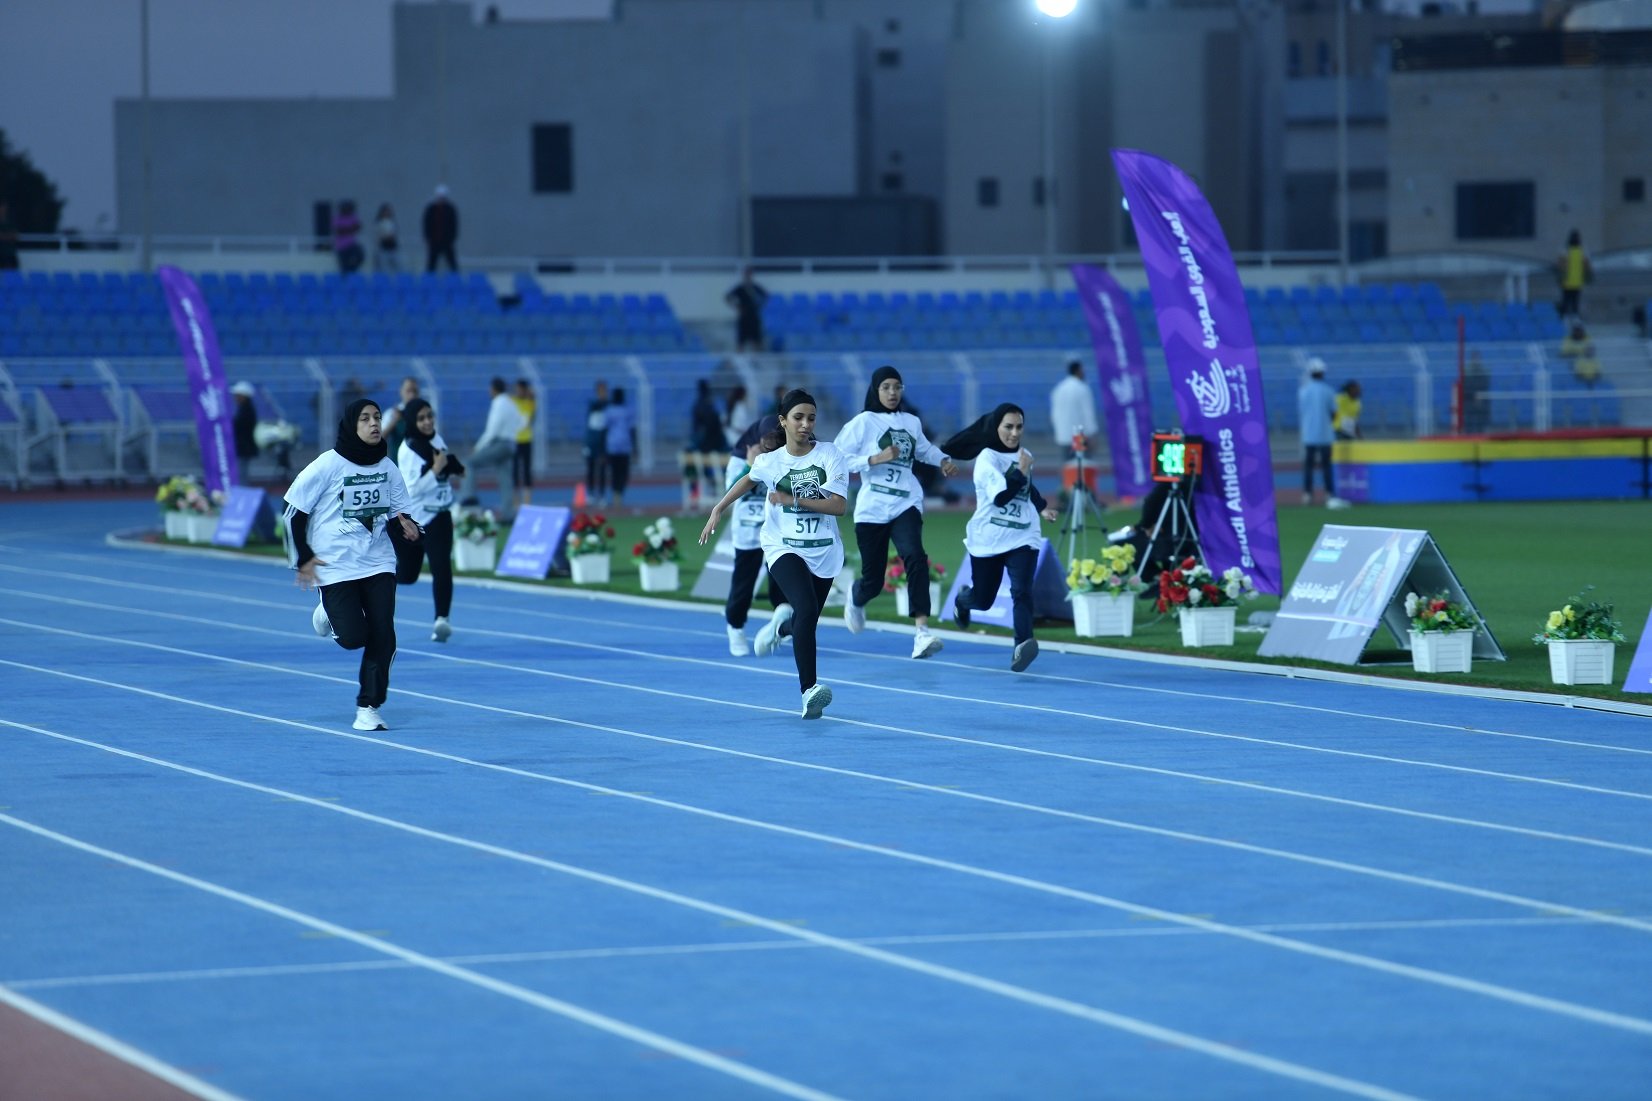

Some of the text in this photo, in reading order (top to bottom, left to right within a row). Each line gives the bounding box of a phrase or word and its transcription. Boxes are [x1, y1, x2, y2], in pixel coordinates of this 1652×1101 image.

[1189, 286, 1220, 349] السعودية
[885, 468, 902, 484] 37
[1218, 428, 1242, 513] Athletics
[352, 489, 381, 506] 539
[795, 517, 820, 534] 517
[1230, 516, 1255, 568] Saudi
